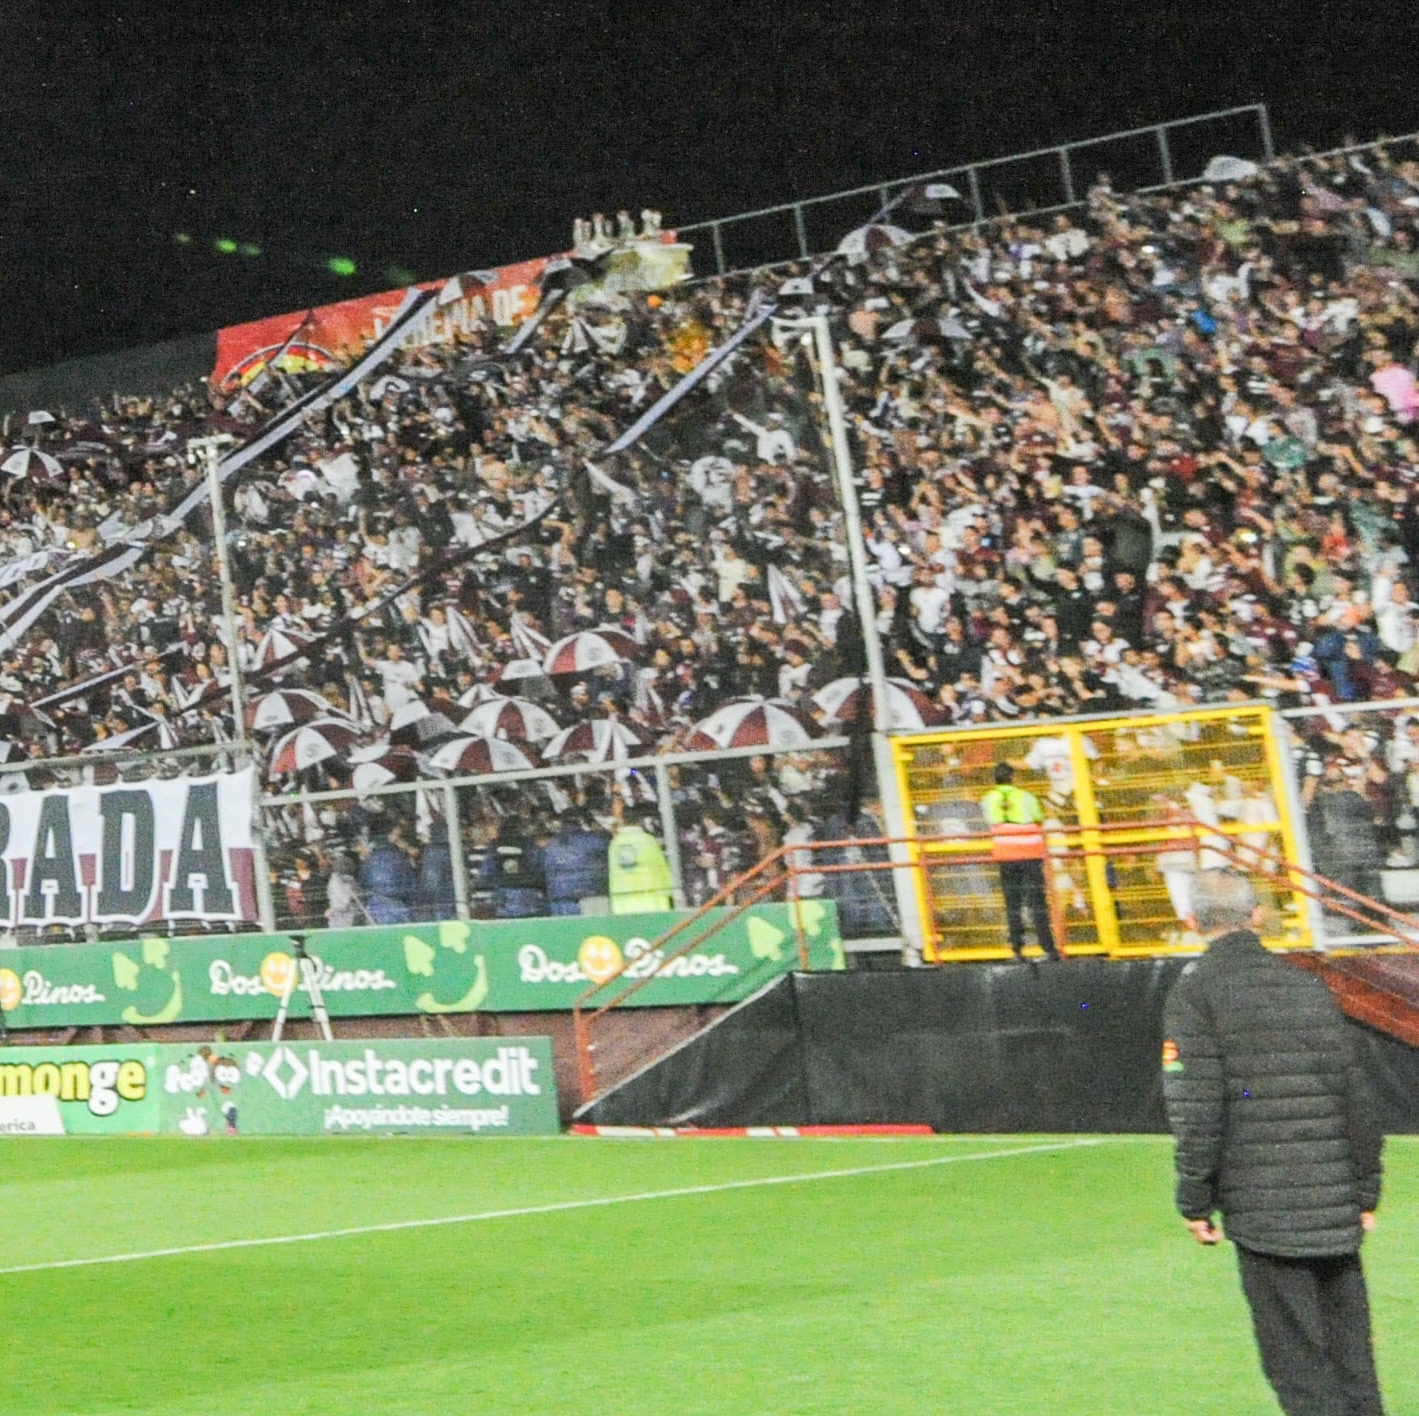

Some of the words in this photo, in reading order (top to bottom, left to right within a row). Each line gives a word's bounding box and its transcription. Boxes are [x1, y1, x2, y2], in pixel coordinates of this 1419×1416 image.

[209, 960, 262, 995] Dos
[518, 944, 589, 983] Dos
[21, 971, 106, 1005] Pinos
[308, 1047, 541, 1095] Instacredit
